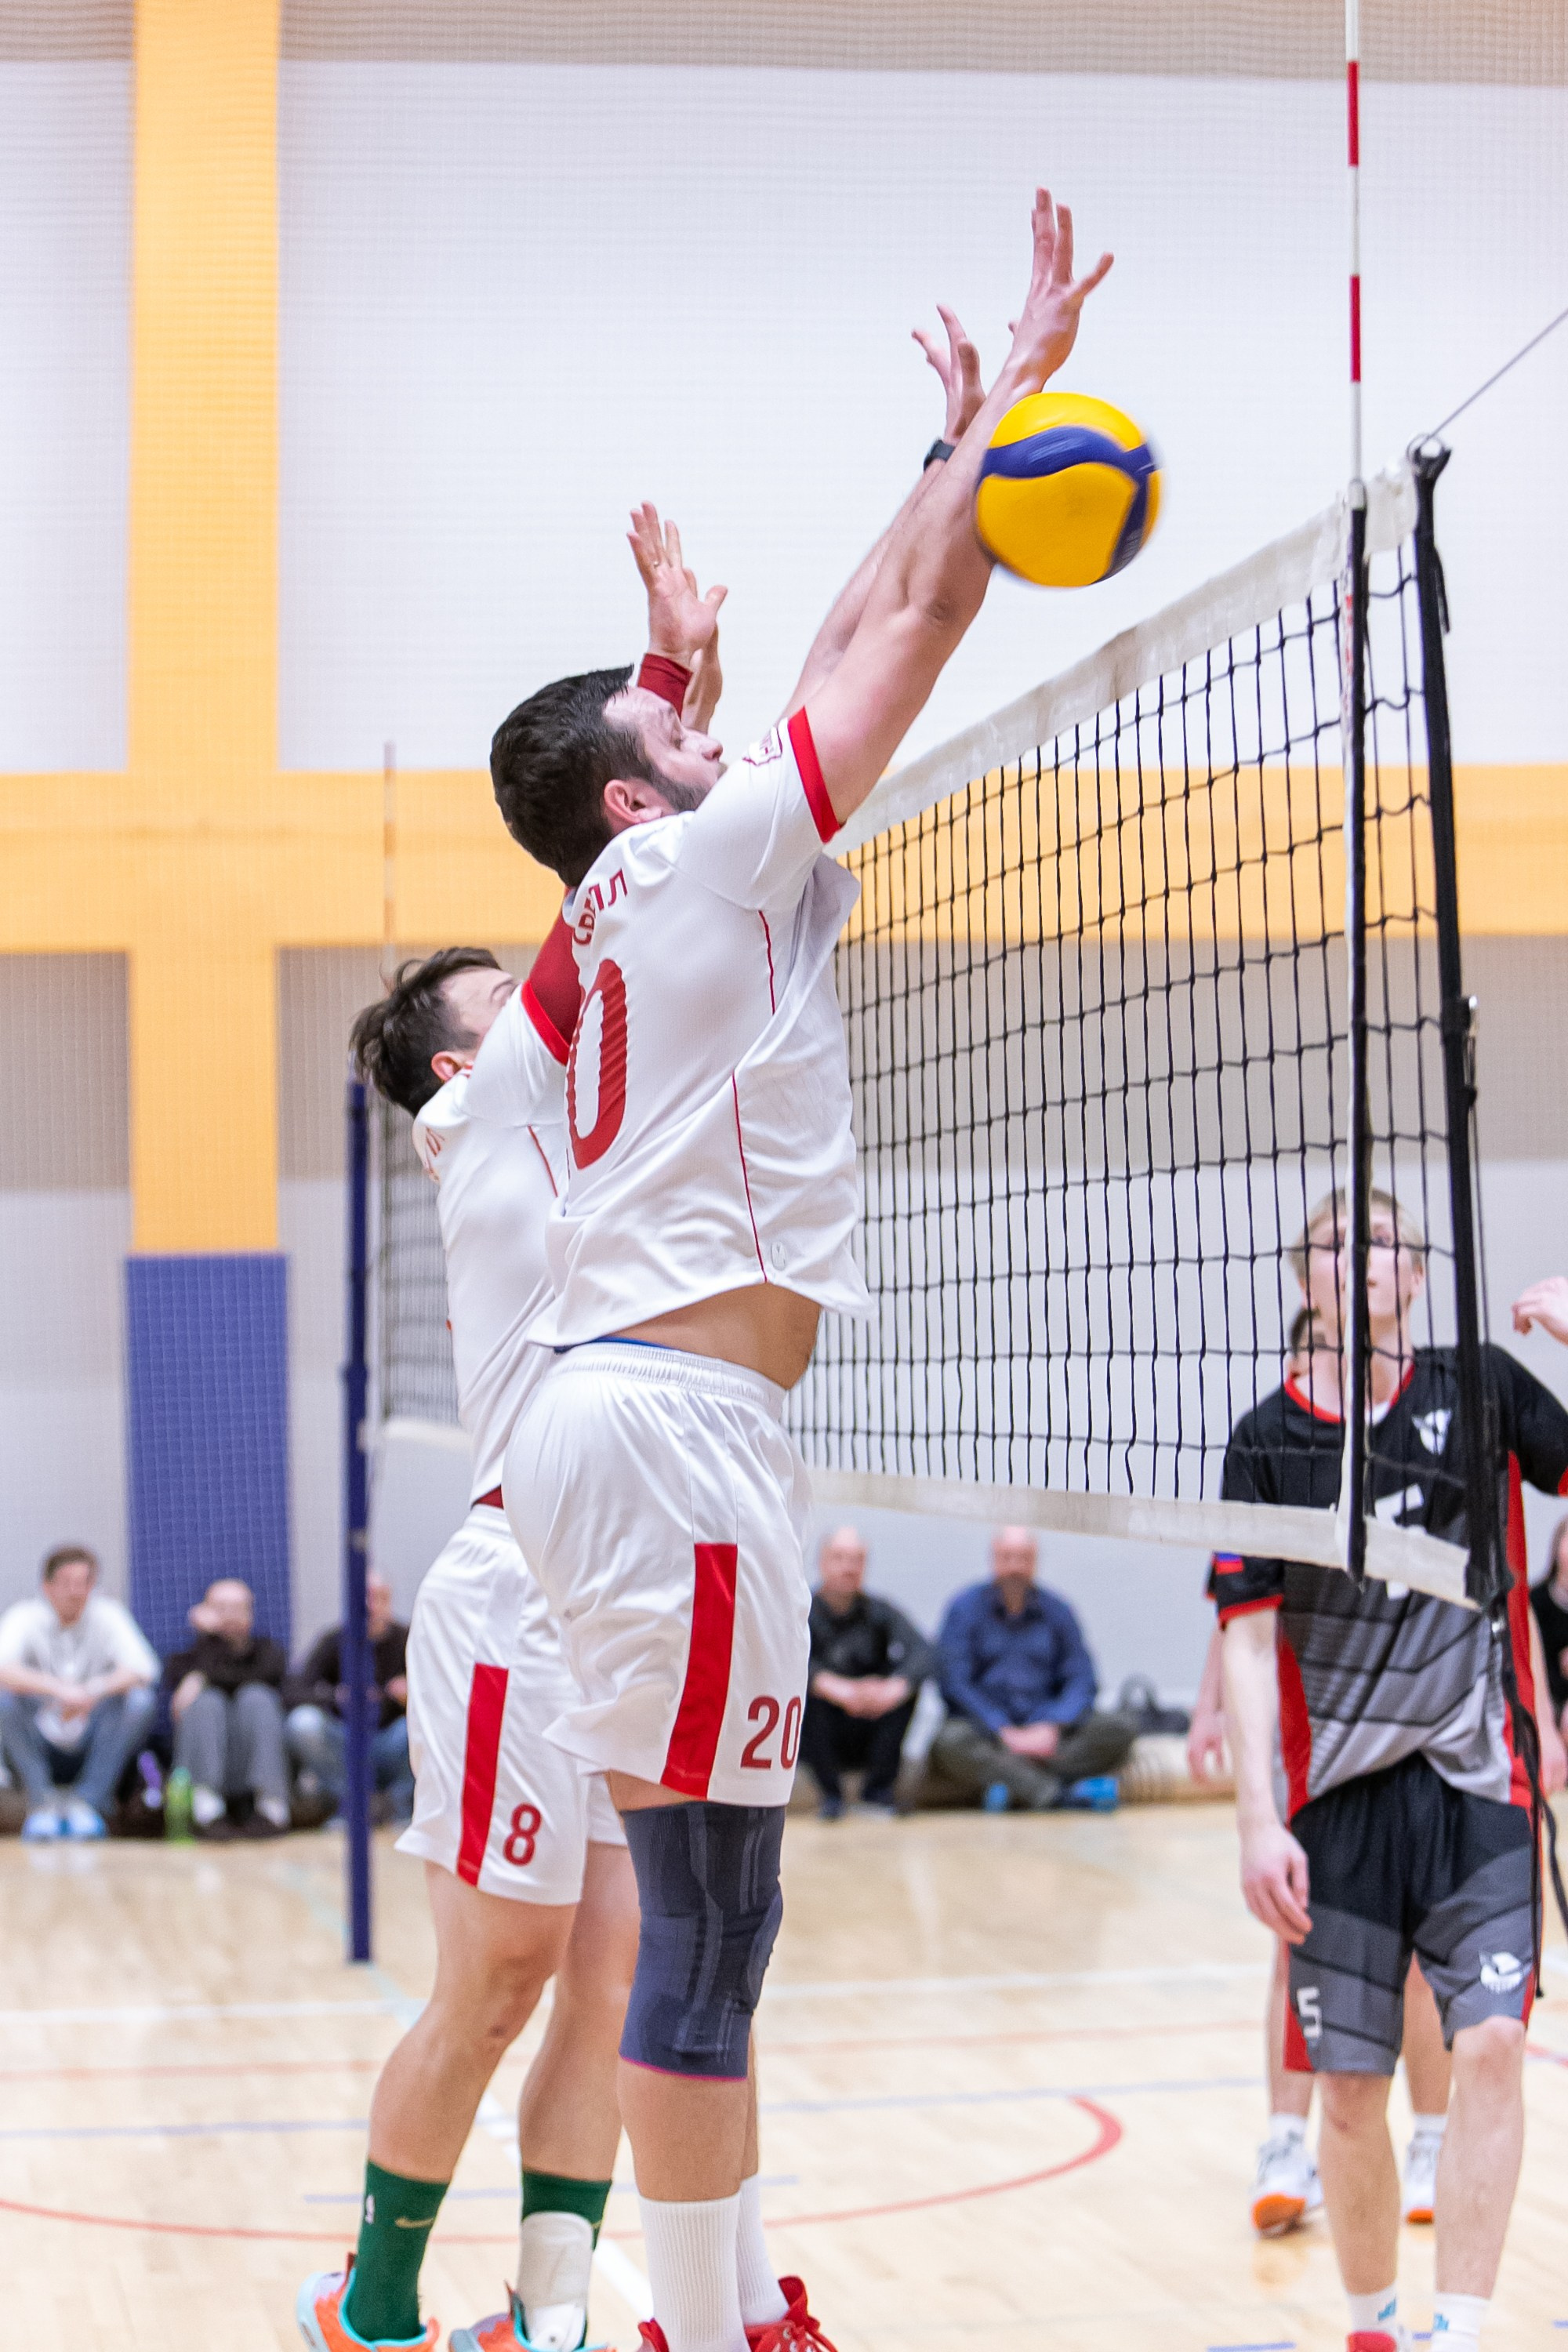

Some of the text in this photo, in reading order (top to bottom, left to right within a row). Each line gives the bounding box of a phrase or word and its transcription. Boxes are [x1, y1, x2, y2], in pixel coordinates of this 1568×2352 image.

[740, 1697, 801, 1769] 20
[503, 1803, 542, 1866] 8
[1297, 1987, 1323, 2039] 5
